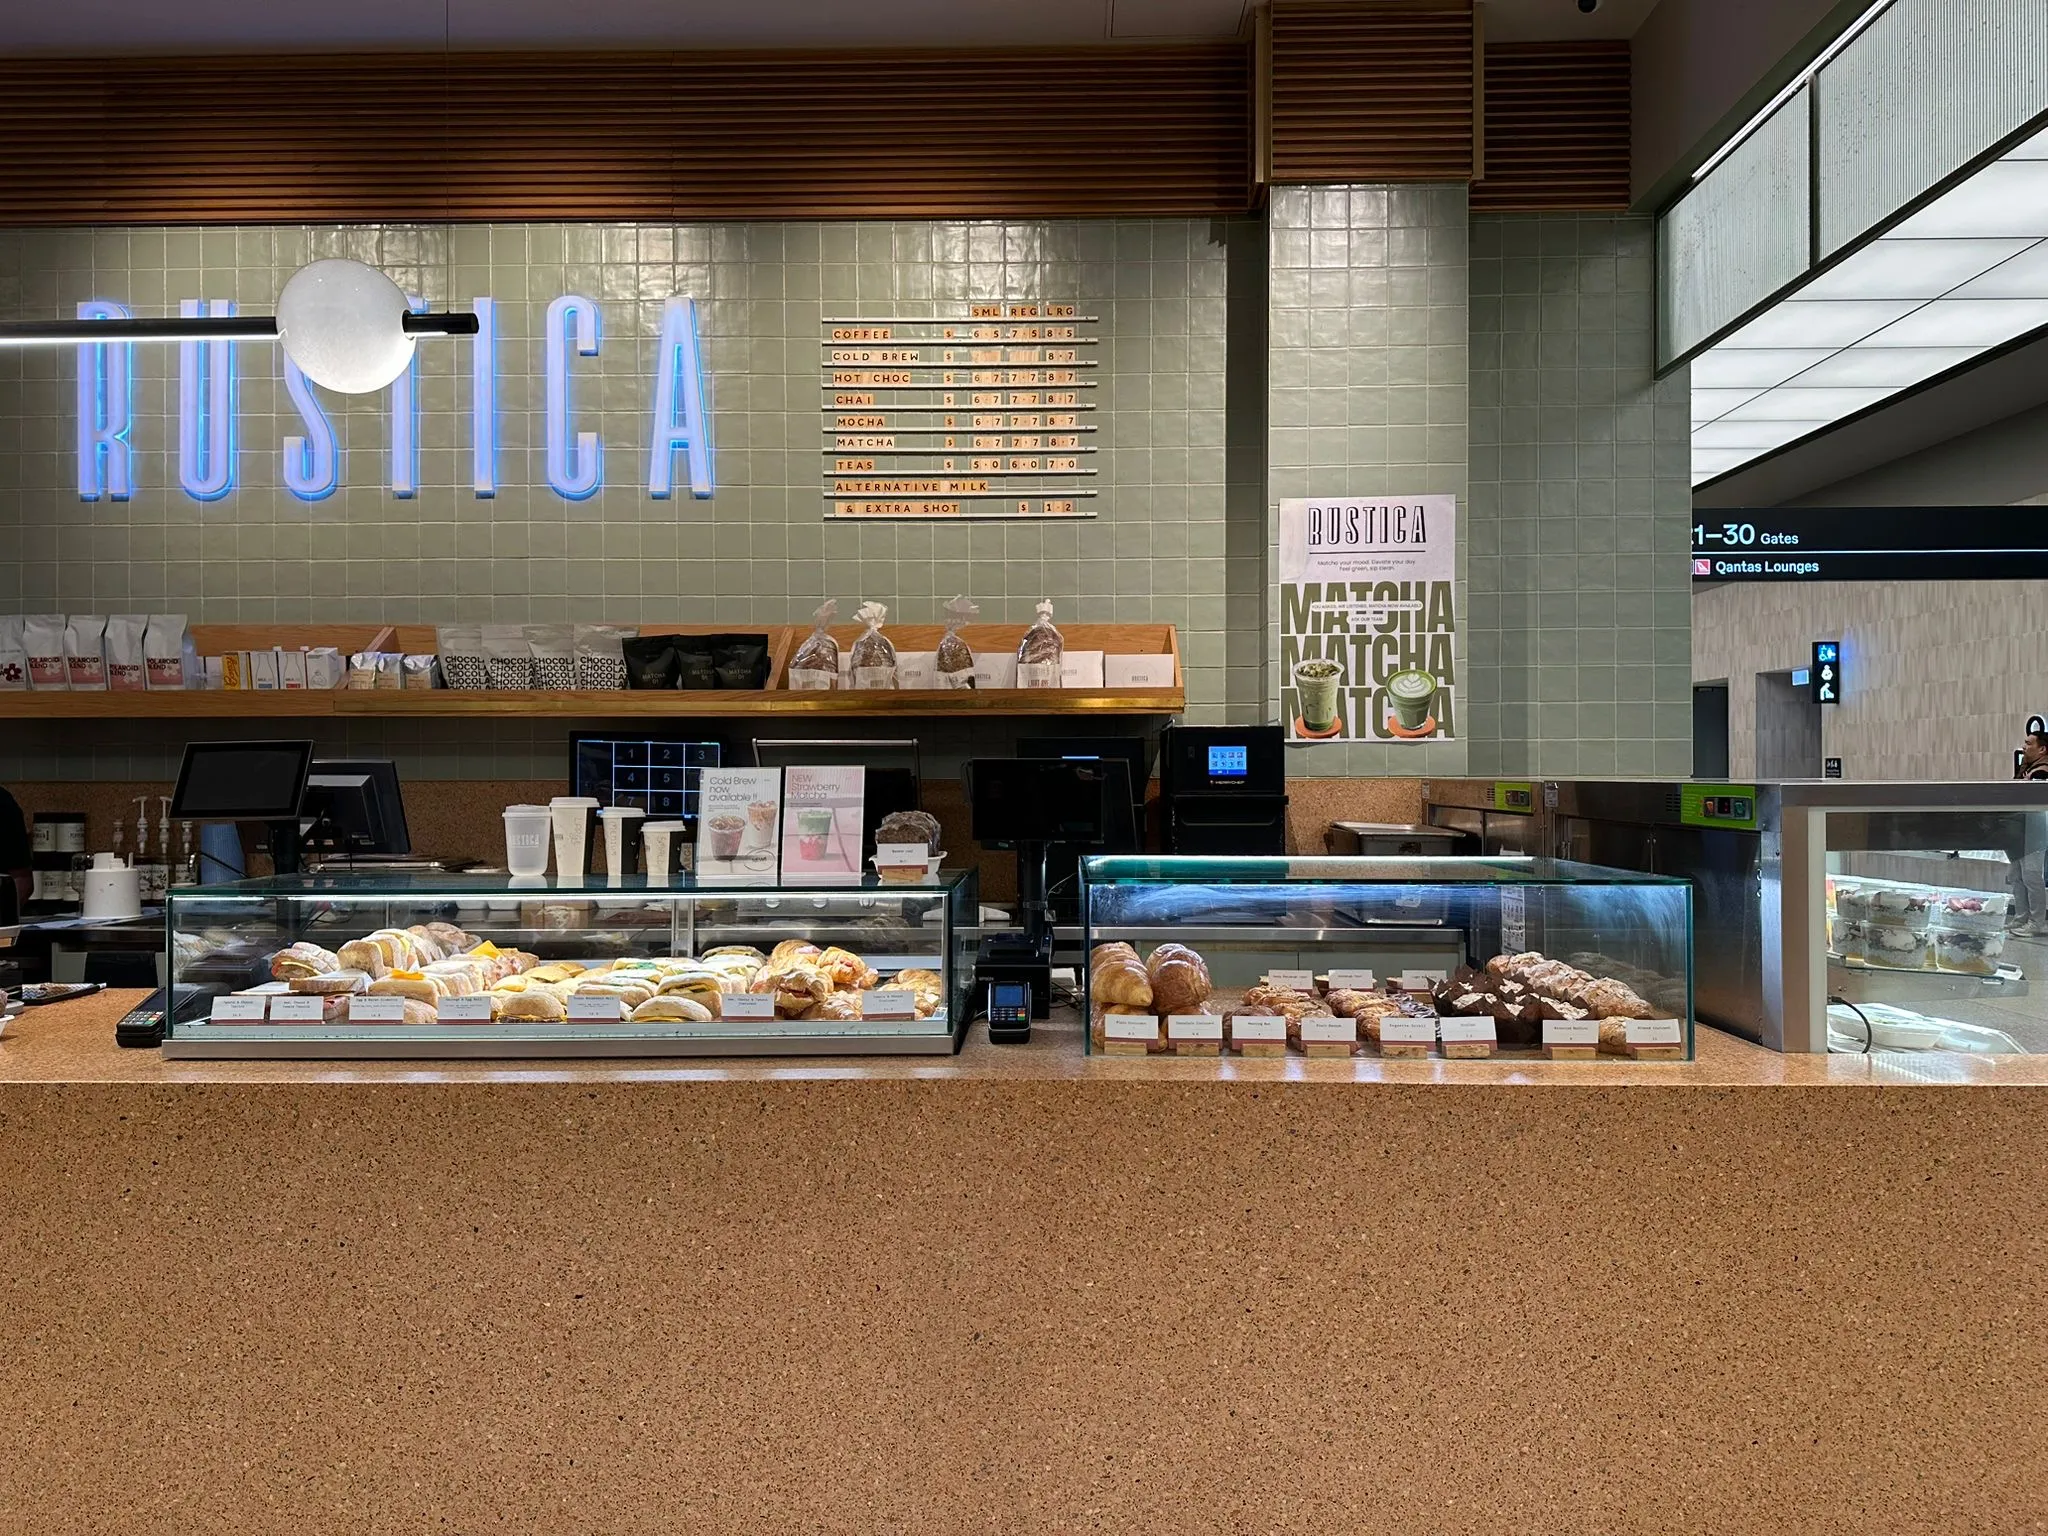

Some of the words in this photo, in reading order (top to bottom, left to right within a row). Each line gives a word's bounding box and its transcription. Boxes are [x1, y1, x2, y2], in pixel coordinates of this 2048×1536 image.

[973, 308, 998, 316] SML
[1011, 308, 1037, 316] REG
[1047, 307, 1073, 315] LRG
[833, 331, 889, 339] COFFEE
[833, 353, 869, 361] COLD
[882, 353, 918, 361] BREW
[834, 374, 861, 382] HOT
[873, 374, 910, 382] CHOC
[76, 294, 714, 502] RUSTICA
[836, 396, 871, 404] CHAI
[837, 418, 884, 426] MOCHA
[837, 439, 893, 447] MATCHA
[838, 461, 873, 470] TEAS
[836, 483, 938, 491] ALTERNATIVE
[950, 482, 986, 491] MILK
[846, 505, 853, 513] &
[866, 505, 911, 513] EXTRA
[923, 505, 958, 513] SHOT
[1308, 506, 1426, 545] RUSTICA
[1760, 533, 1799, 545] Gates
[1715, 560, 1762, 575] Qantas
[1764, 560, 1819, 575] Lounges
[1280, 581, 1455, 635] MATCHA
[1280, 634, 1455, 687] MATCHA
[629, 750, 634, 758] 1
[663, 750, 670, 759] 2
[699, 750, 705, 759] 3
[627, 773, 635, 783] 4
[663, 773, 671, 783] 5
[709, 776, 732, 785] Cold
[733, 776, 757, 785] Brew
[791, 774, 813, 782] NEW
[709, 786, 730, 794] now
[791, 782, 840, 793] Strawberry
[791, 790, 827, 800] Matcha
[628, 797, 634, 805] 7
[663, 797, 670, 807] 8
